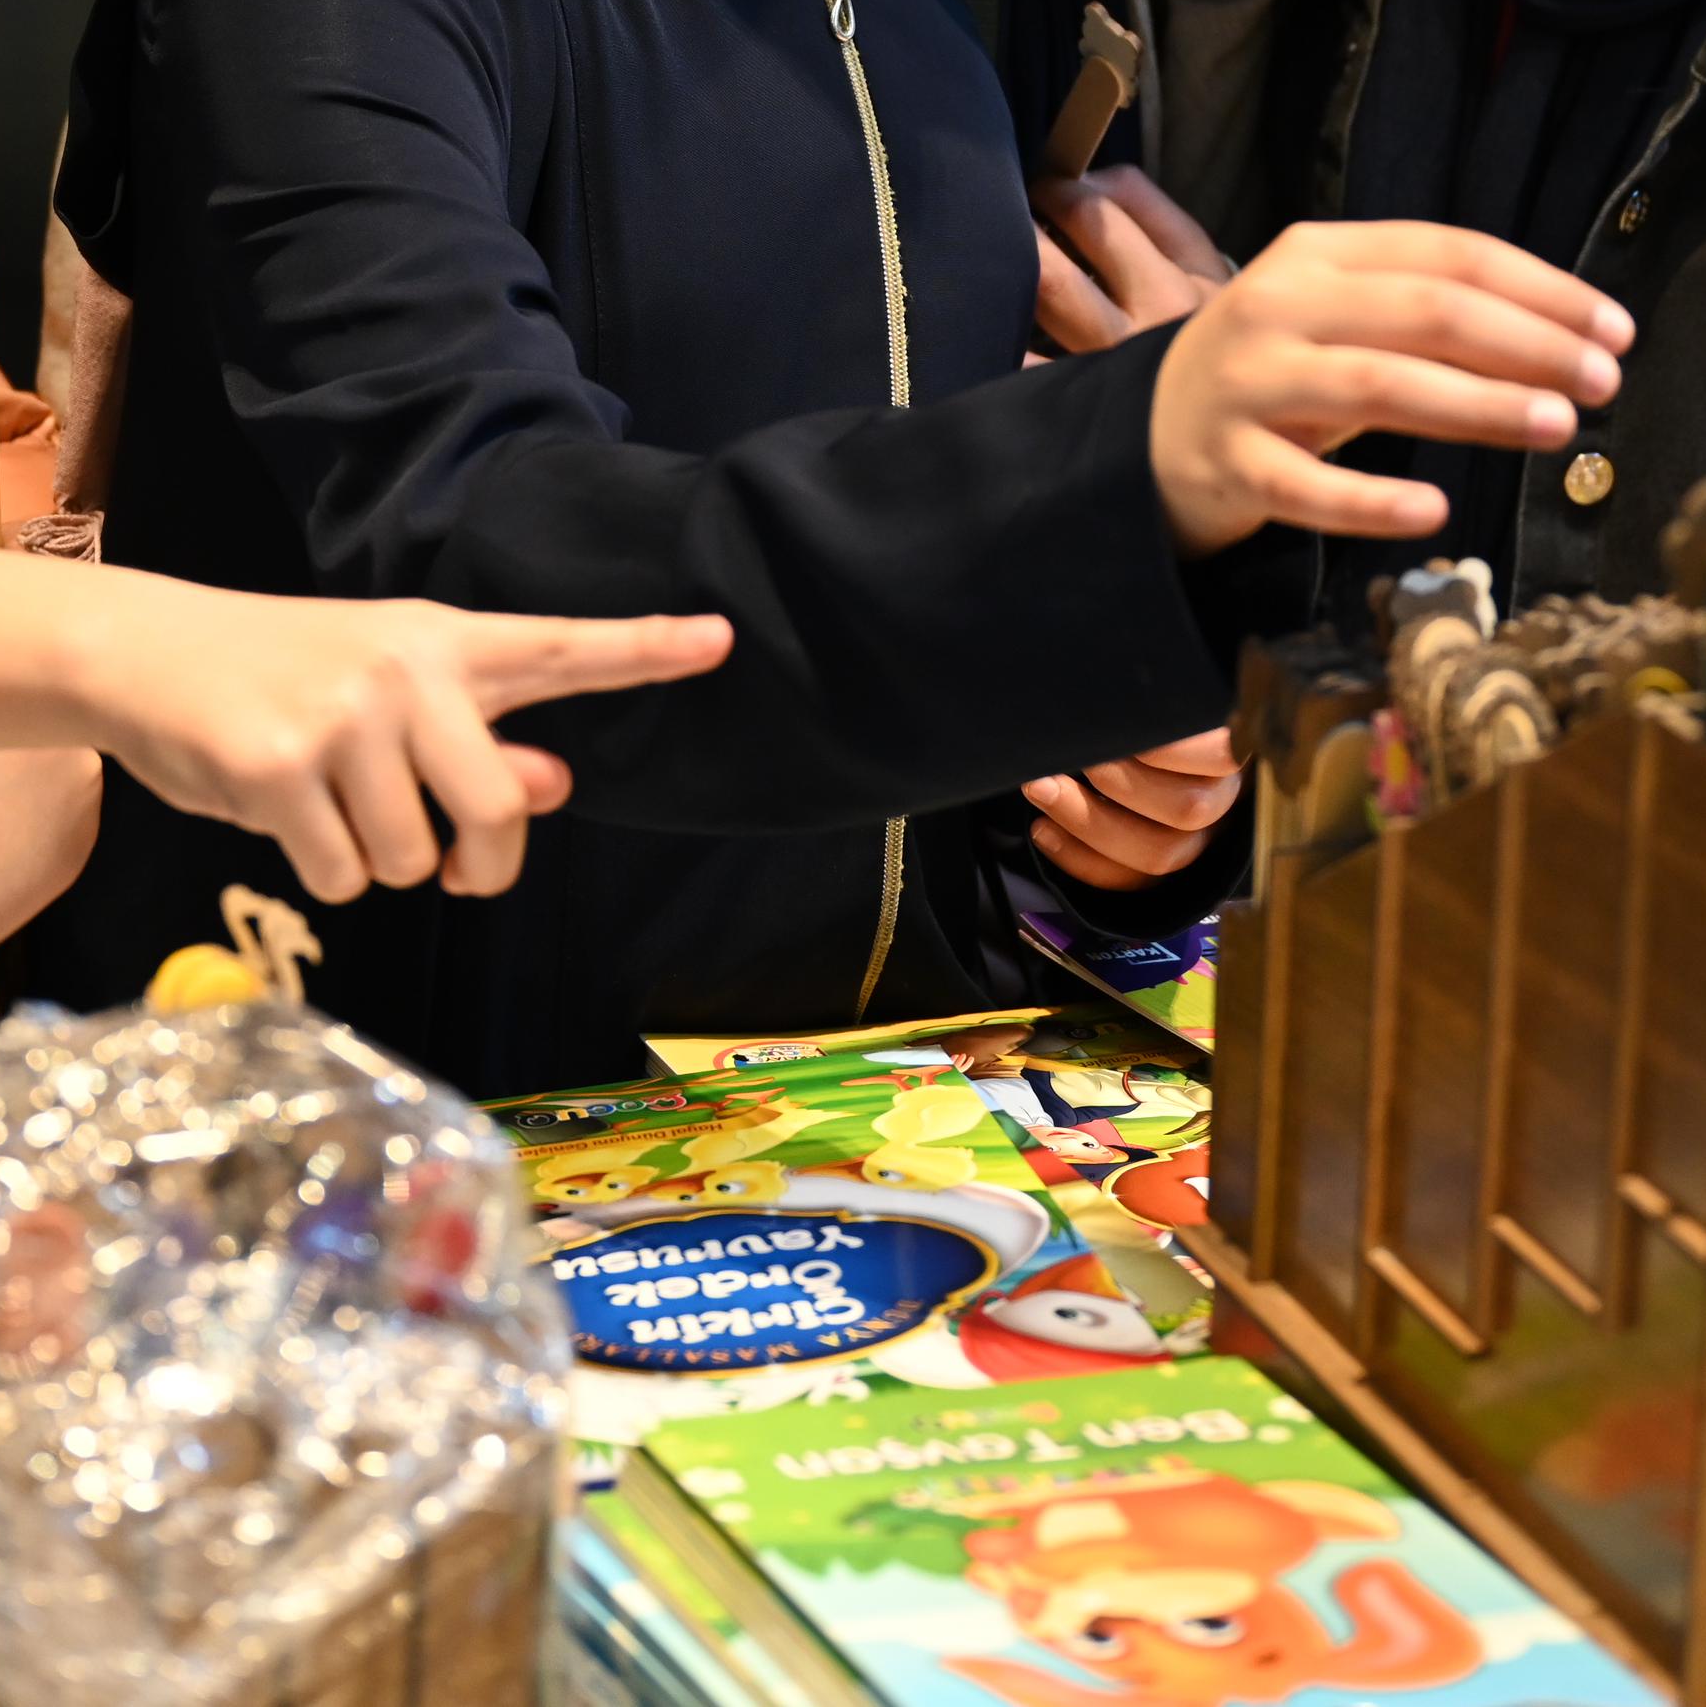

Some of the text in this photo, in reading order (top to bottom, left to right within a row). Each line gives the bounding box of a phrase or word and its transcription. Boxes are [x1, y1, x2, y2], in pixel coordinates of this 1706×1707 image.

[1086, 945, 1161, 964] KARTON
[670, 1121, 724, 1139] Hayal
[551, 1225, 864, 1282] Yavrusu
[603, 1259, 844, 1309] Ördek
[627, 1289, 866, 1344] Çirkin
[1081, 1408, 1251, 1450] Ben
